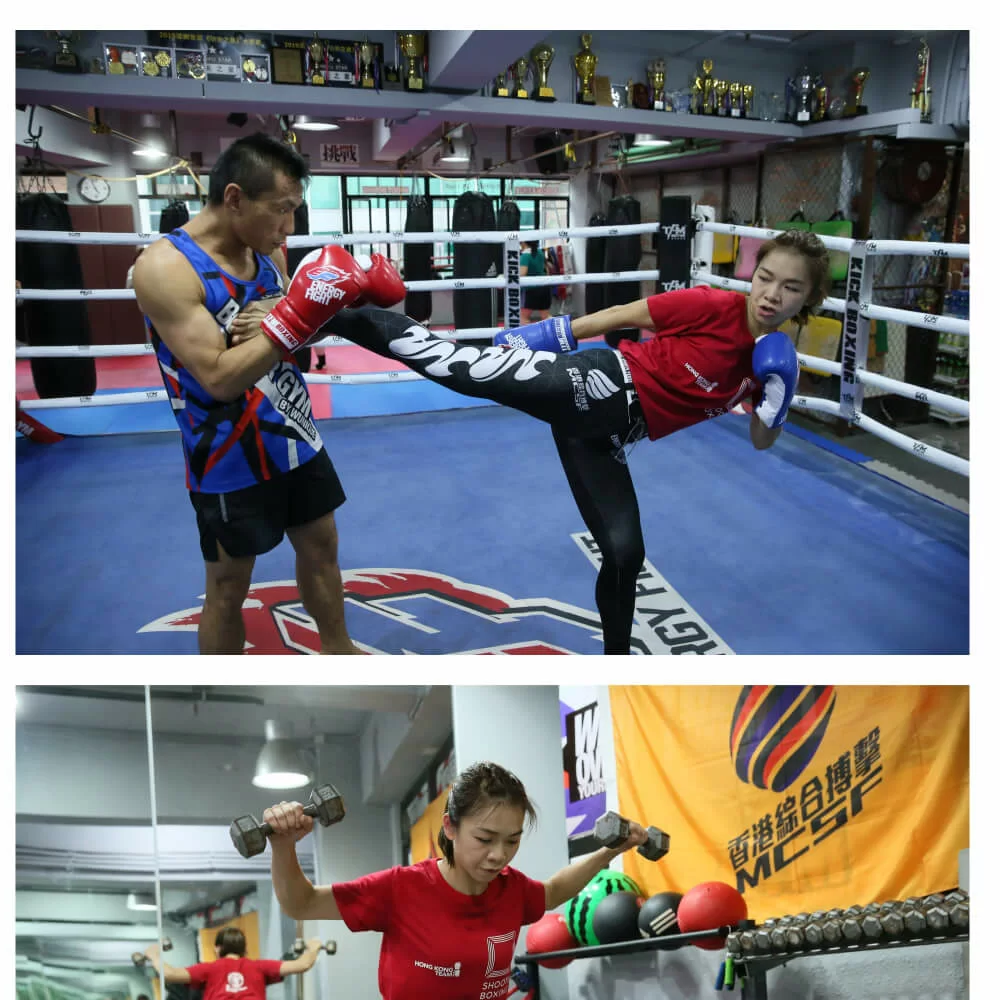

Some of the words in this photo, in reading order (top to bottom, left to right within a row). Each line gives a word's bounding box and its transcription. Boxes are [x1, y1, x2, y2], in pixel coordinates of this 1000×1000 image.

[507, 249, 519, 285] KICK
[848, 256, 864, 305] KICK
[304, 286, 332, 306] FIGHT
[311, 280, 347, 301] ENERGY
[275, 322, 300, 348] BOXING
[843, 307, 859, 386] BOXING
[276, 367, 313, 420] GYM
[279, 399, 291, 415] BY
[735, 763, 884, 895] MCSF
[414, 960, 433, 970] HONG
[434, 965, 454, 973] KONG
